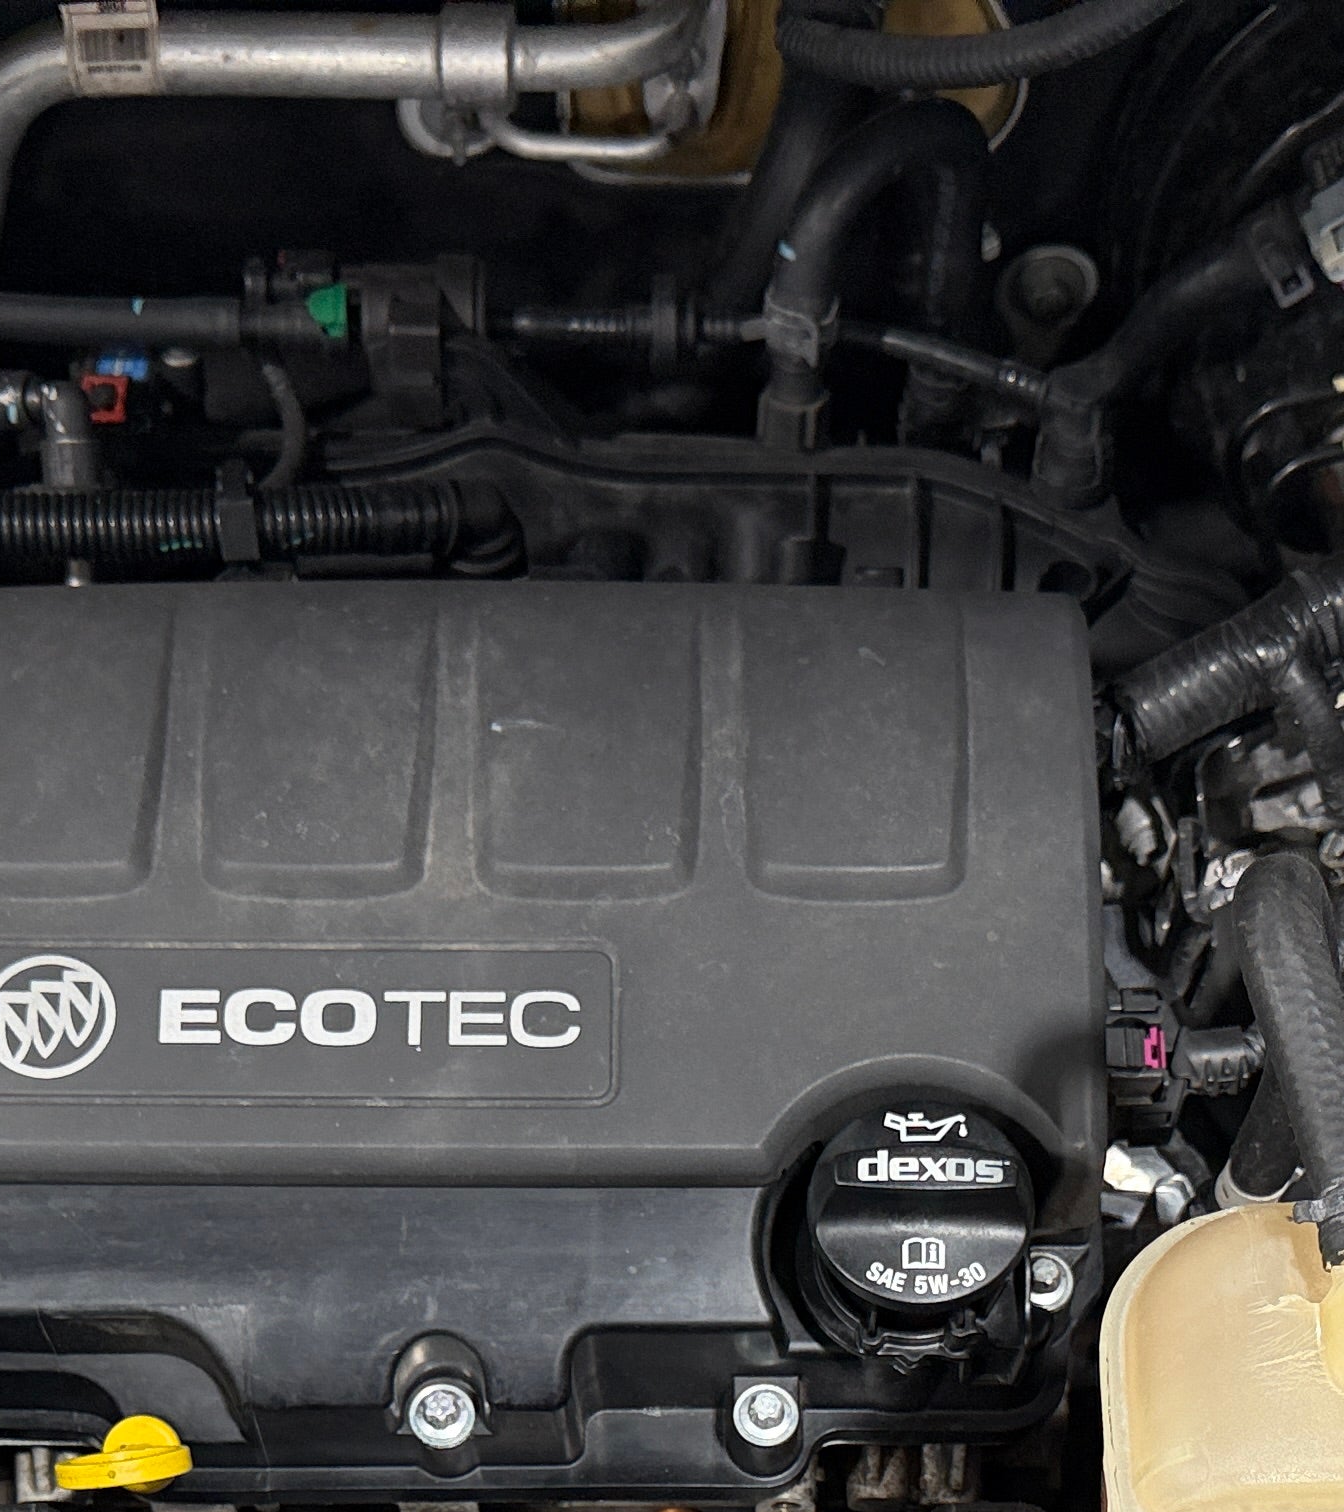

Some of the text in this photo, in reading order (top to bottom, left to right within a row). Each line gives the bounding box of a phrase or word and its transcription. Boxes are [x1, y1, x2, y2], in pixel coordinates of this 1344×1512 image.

[158, 989, 581, 1048] ECOTEC
[857, 1152, 1004, 1184] dexos
[865, 1260, 988, 1297] SAE 5W-30
